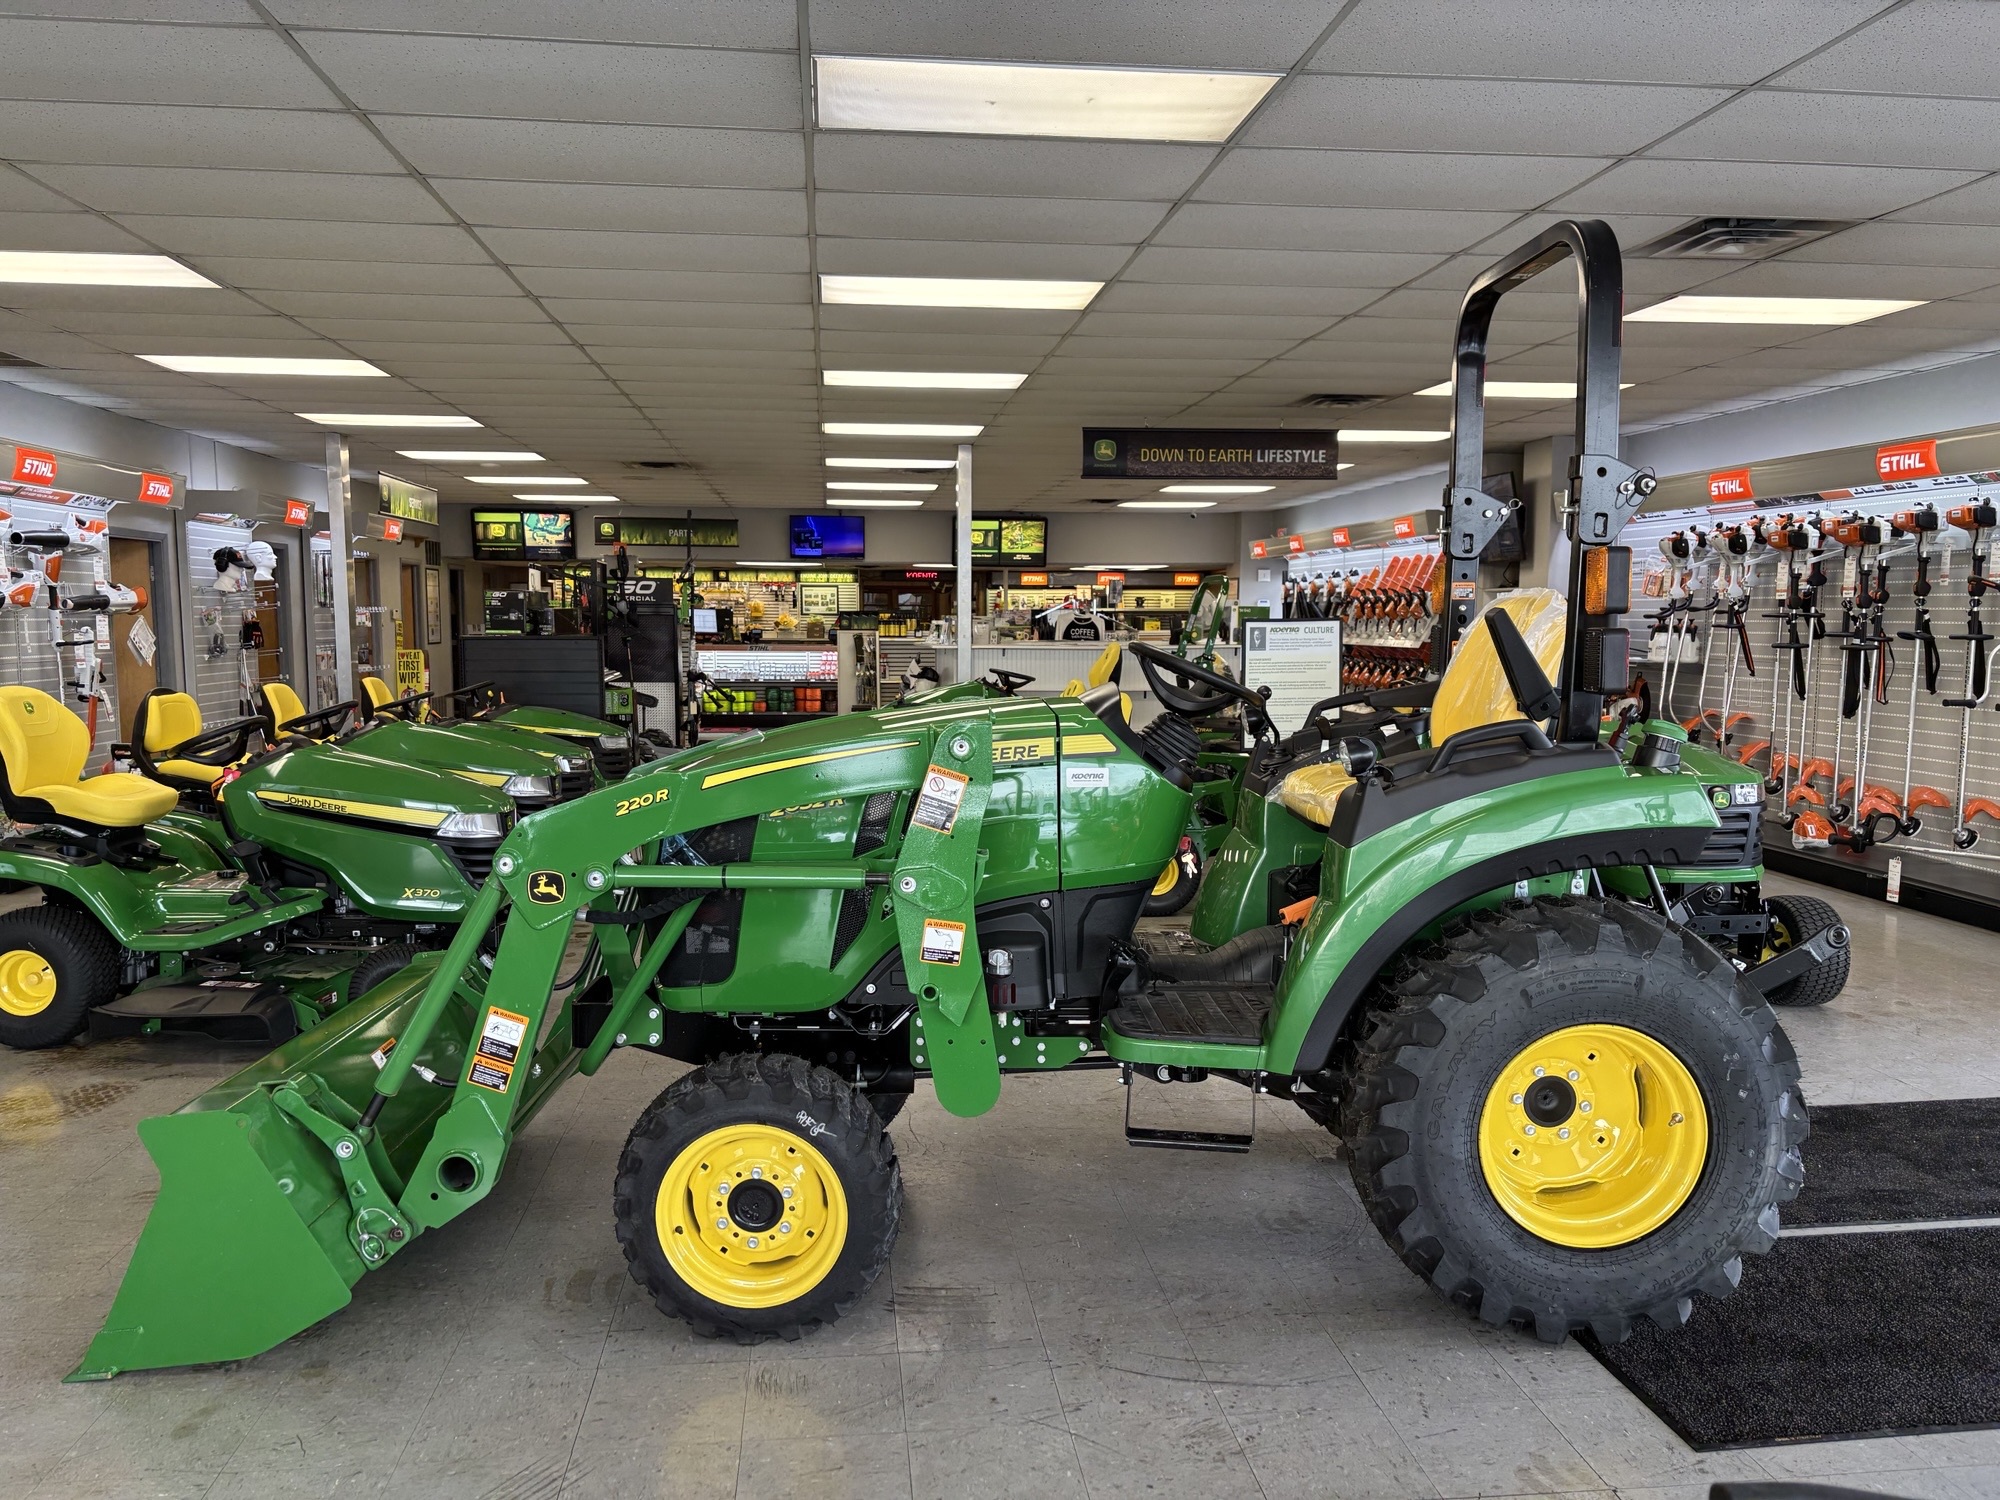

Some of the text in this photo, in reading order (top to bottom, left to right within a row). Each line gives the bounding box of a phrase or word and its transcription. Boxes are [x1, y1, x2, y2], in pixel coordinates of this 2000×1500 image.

[1140, 448, 1326, 463] DOWN TO EARTH LIFESTYLE
[22, 458, 54, 477] STIHL
[1880, 453, 1925, 473] STIHL
[147, 483, 171, 498] STIHL
[1711, 479, 1744, 496] STIHL
[290, 508, 307, 520] STIHL
[1394, 523, 1411, 534] STIHL
[1333, 533, 1346, 543] STIHL
[1070, 628, 1095, 637] COFFEE
[1304, 626, 1335, 634] CULTURE
[413, 651, 420, 660] AT
[398, 660, 420, 671] FIRST
[398, 672, 421, 684] WIPE
[992, 744, 1040, 760] EERE
[936, 767, 966, 782] WARNING
[284, 794, 348, 813] JOHN DEERE
[401, 887, 441, 899] X370
[933, 921, 964, 930] WARNING
[499, 1012, 524, 1023] WARNING
[484, 1061, 509, 1072] WARNING
